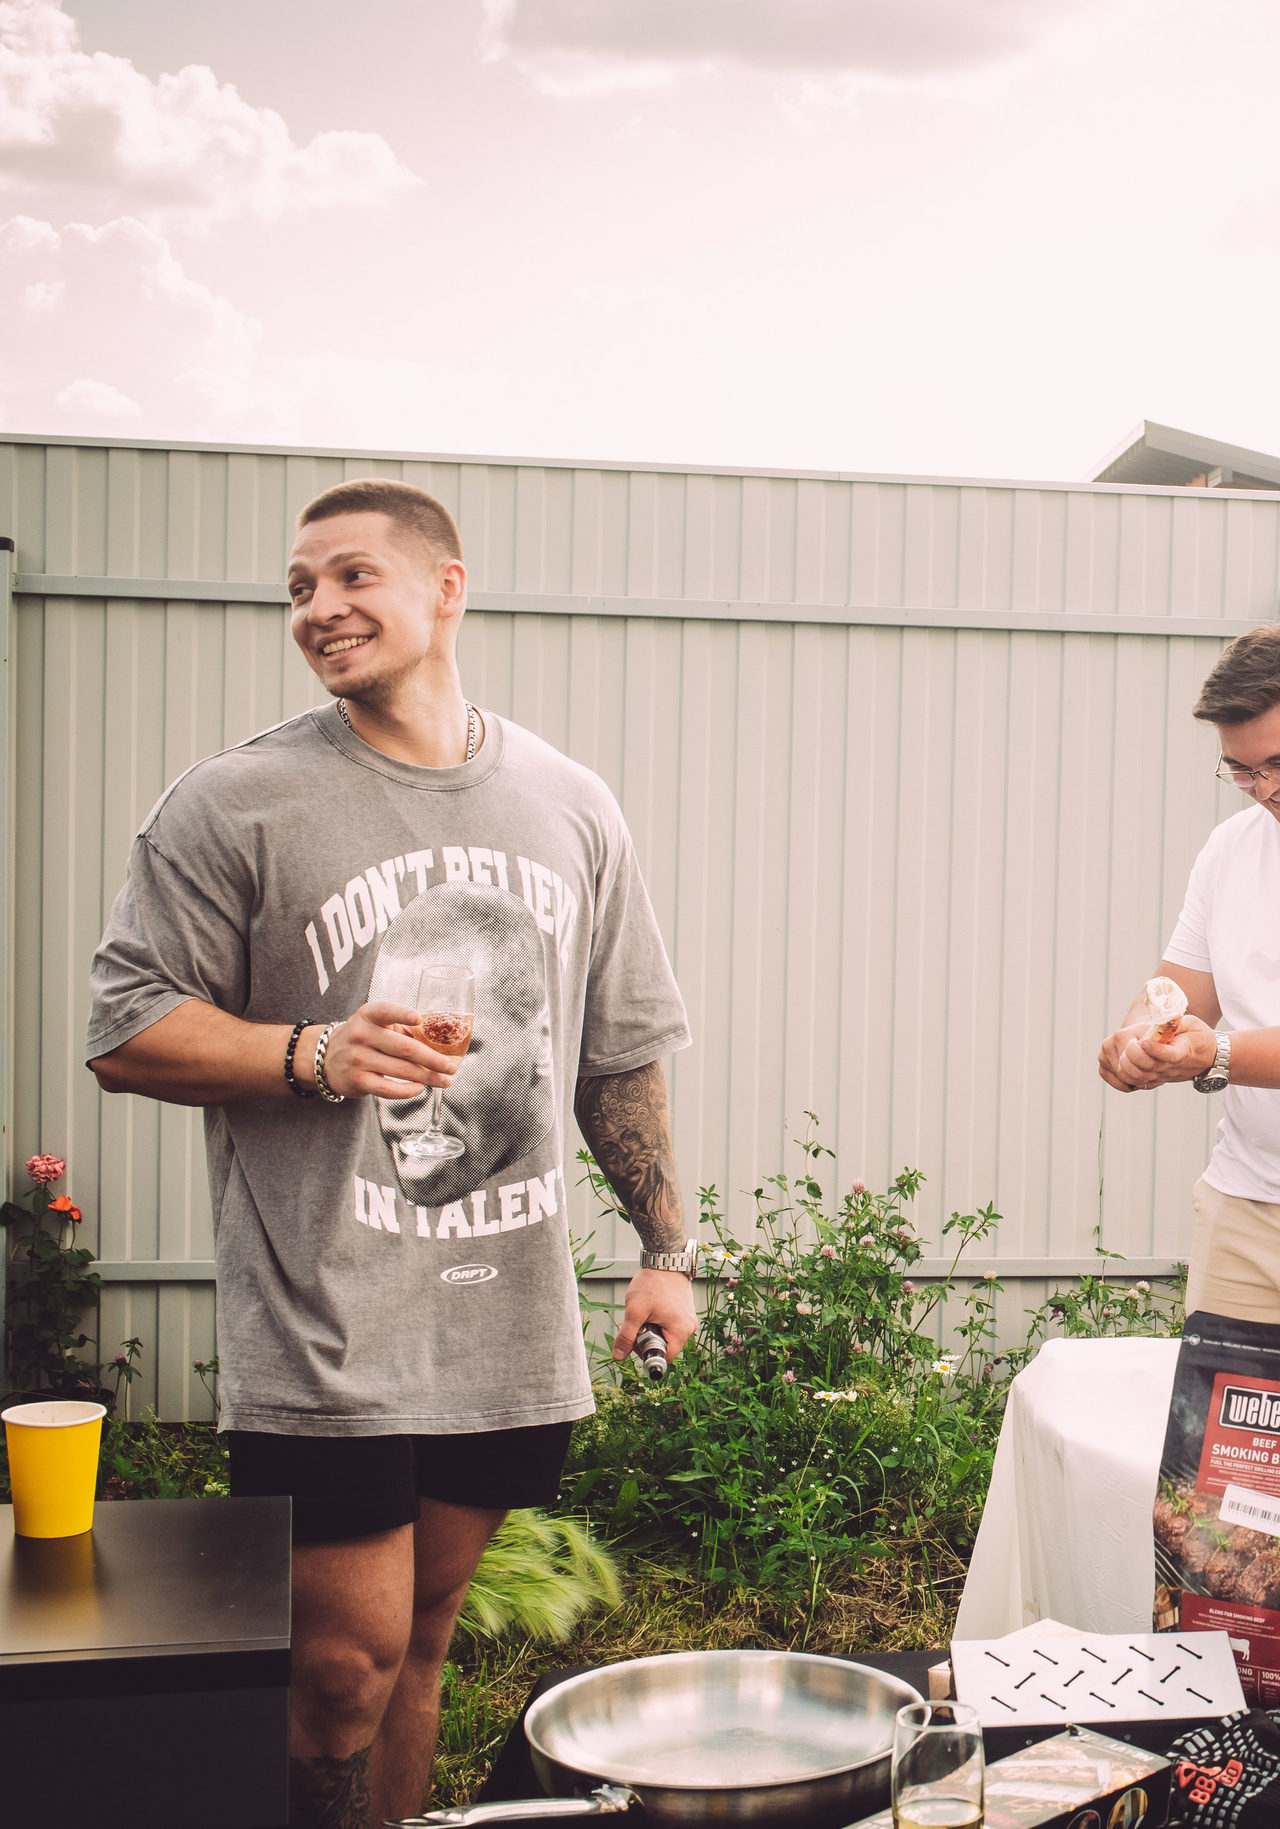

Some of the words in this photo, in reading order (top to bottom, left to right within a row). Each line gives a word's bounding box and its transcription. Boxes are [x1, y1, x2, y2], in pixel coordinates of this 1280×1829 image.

[305, 920, 330, 996] I
[320, 848, 434, 974] DON'T
[354, 1174, 401, 1234] IN
[450, 1268, 489, 1282] DRPT
[1252, 1437, 1278, 1450] BEEF
[1211, 1443, 1270, 1464] SMOKING
[1210, 1458, 1223, 1466] FUEL
[1223, 1460, 1233, 1468] THE
[1232, 1462, 1254, 1471] PERFECT
[1253, 1466, 1276, 1475] GRILLING
[1208, 1608, 1224, 1616] BLEND
[1233, 1612, 1254, 1622] SMOKING
[1253, 1616, 1266, 1624] BEEF
